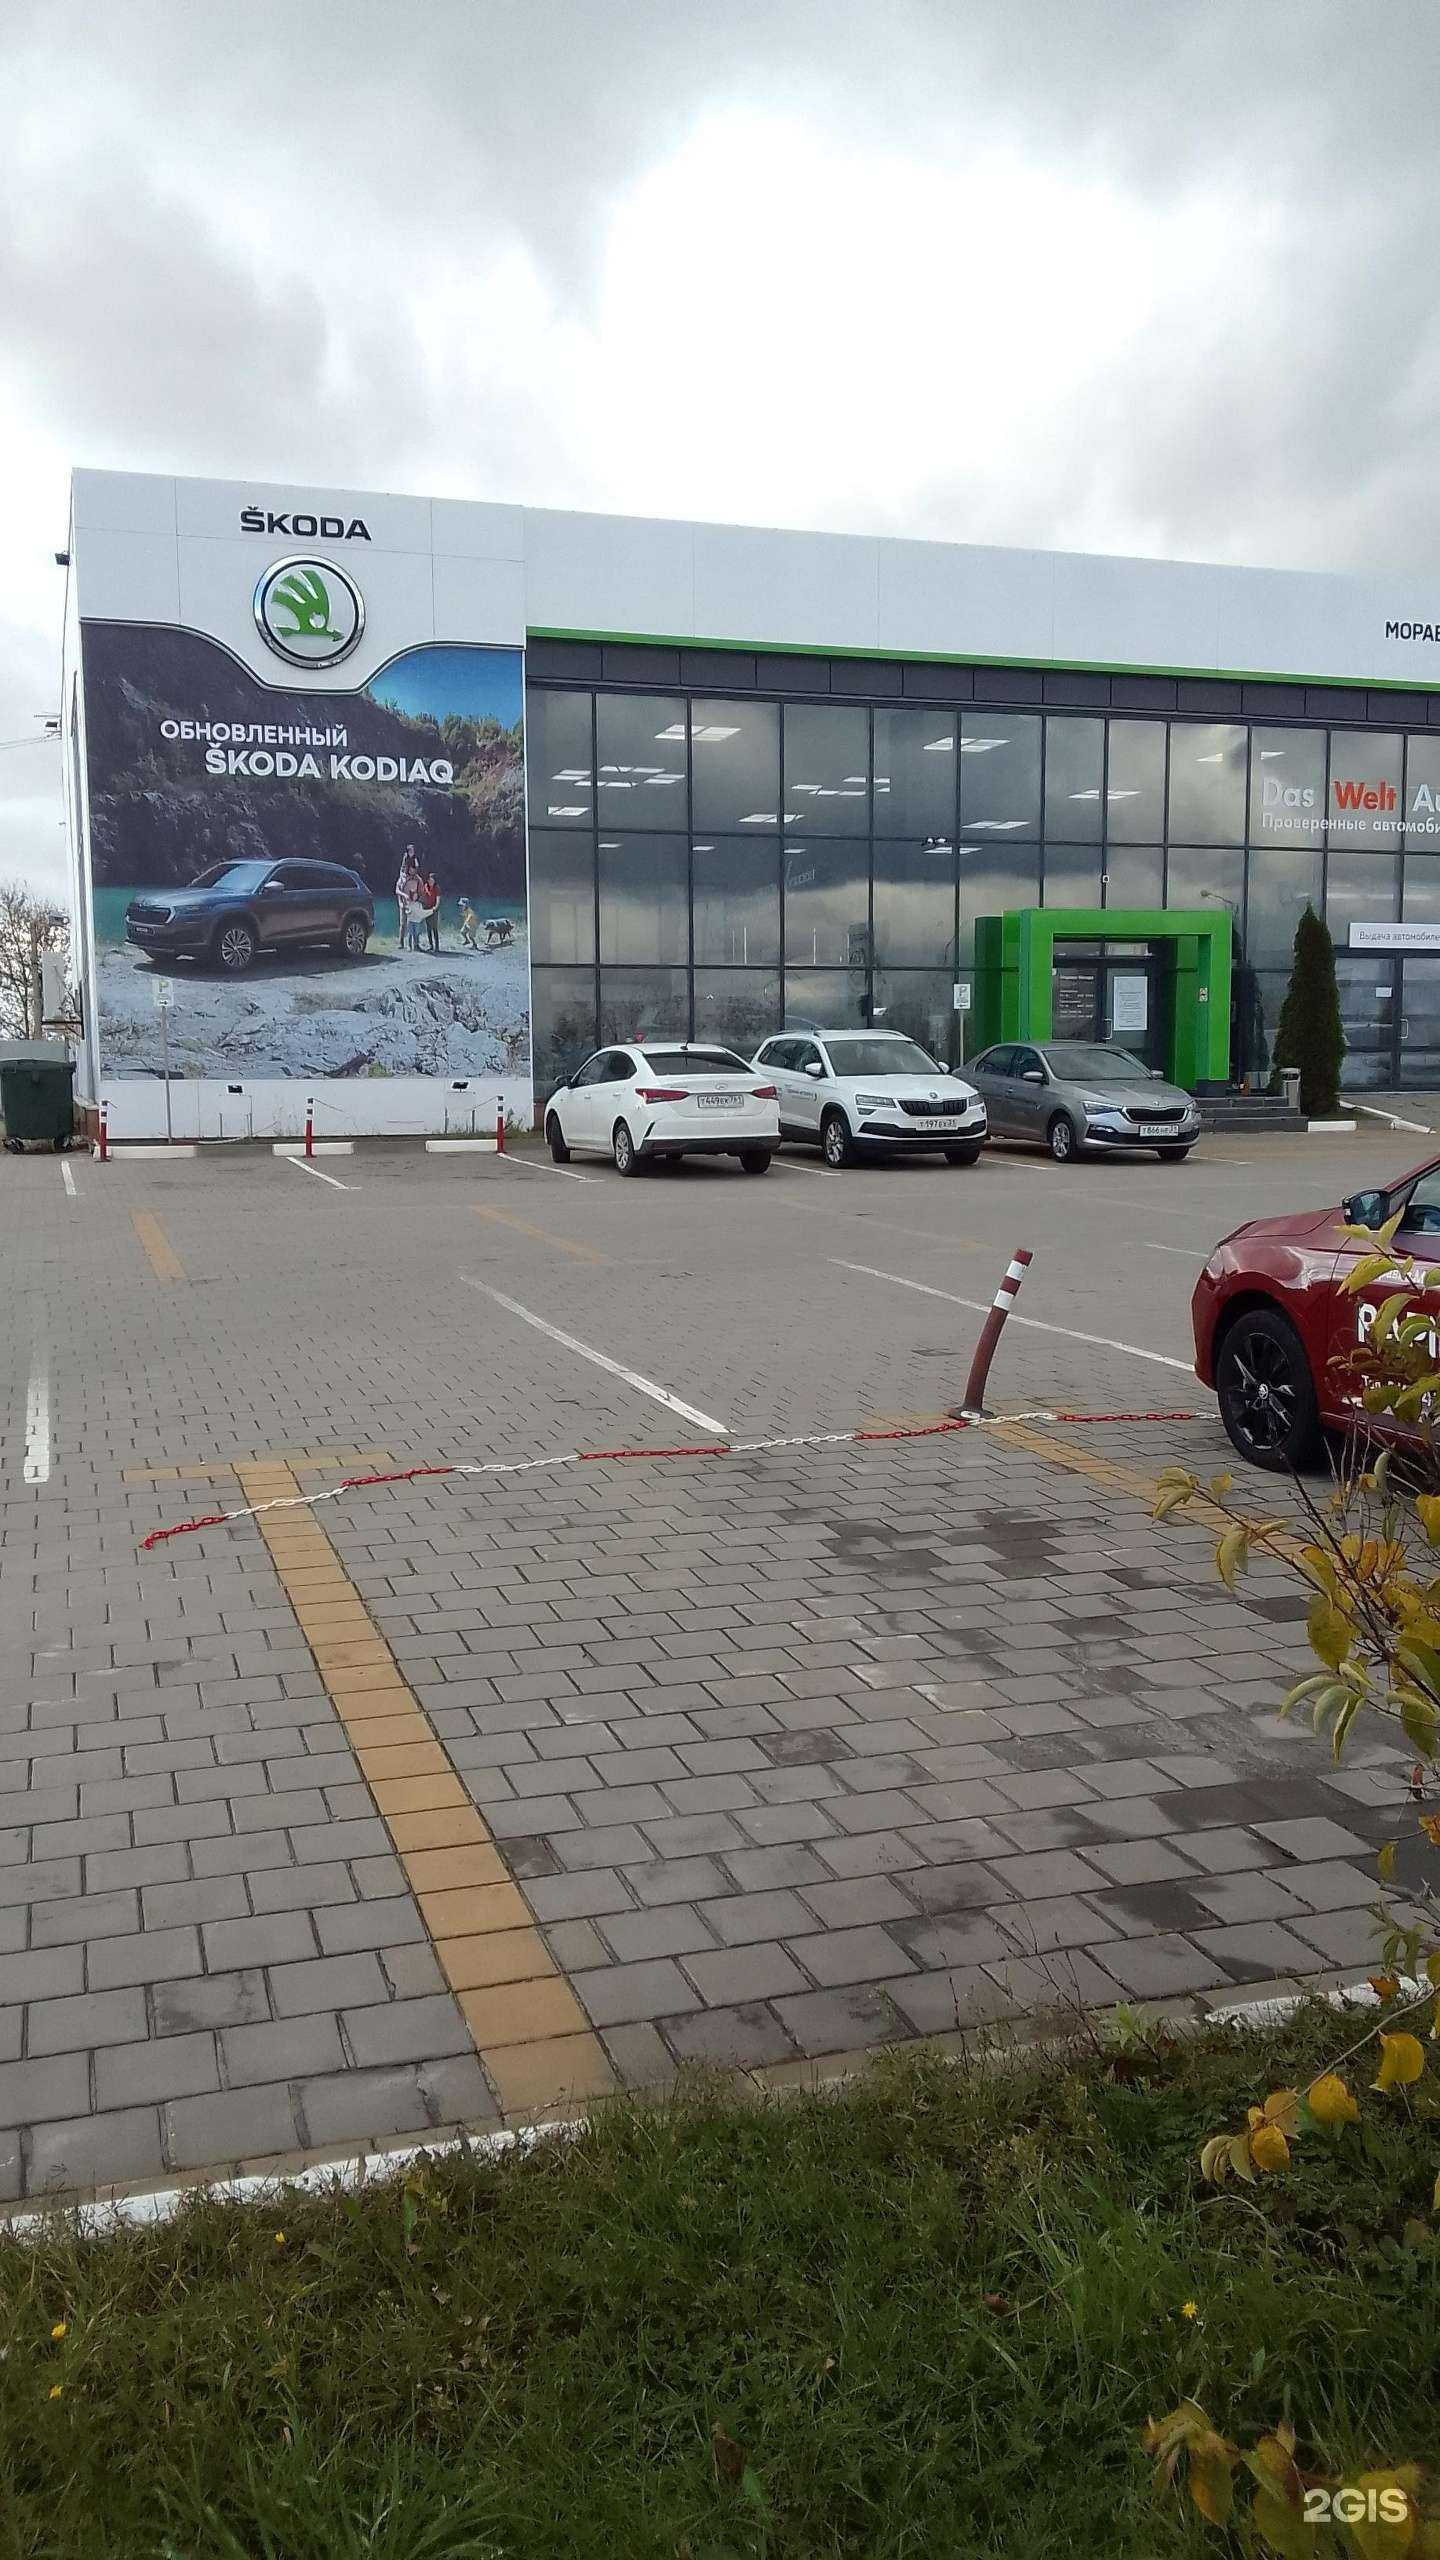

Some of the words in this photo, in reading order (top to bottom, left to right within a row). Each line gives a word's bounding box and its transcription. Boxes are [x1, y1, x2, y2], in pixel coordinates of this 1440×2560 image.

[240, 505, 372, 541] ŠKODA
[160, 719, 348, 747] ОБНОВЛЕННЫЙ
[205, 742, 321, 778] ŠKODA
[330, 754, 454, 784] KODIAQ
[1263, 777, 1315, 808] Das
[1331, 780, 1397, 811] Welt
[1262, 812, 1366, 833] Проверенные
[1359, 930, 1391, 941] Выдача
